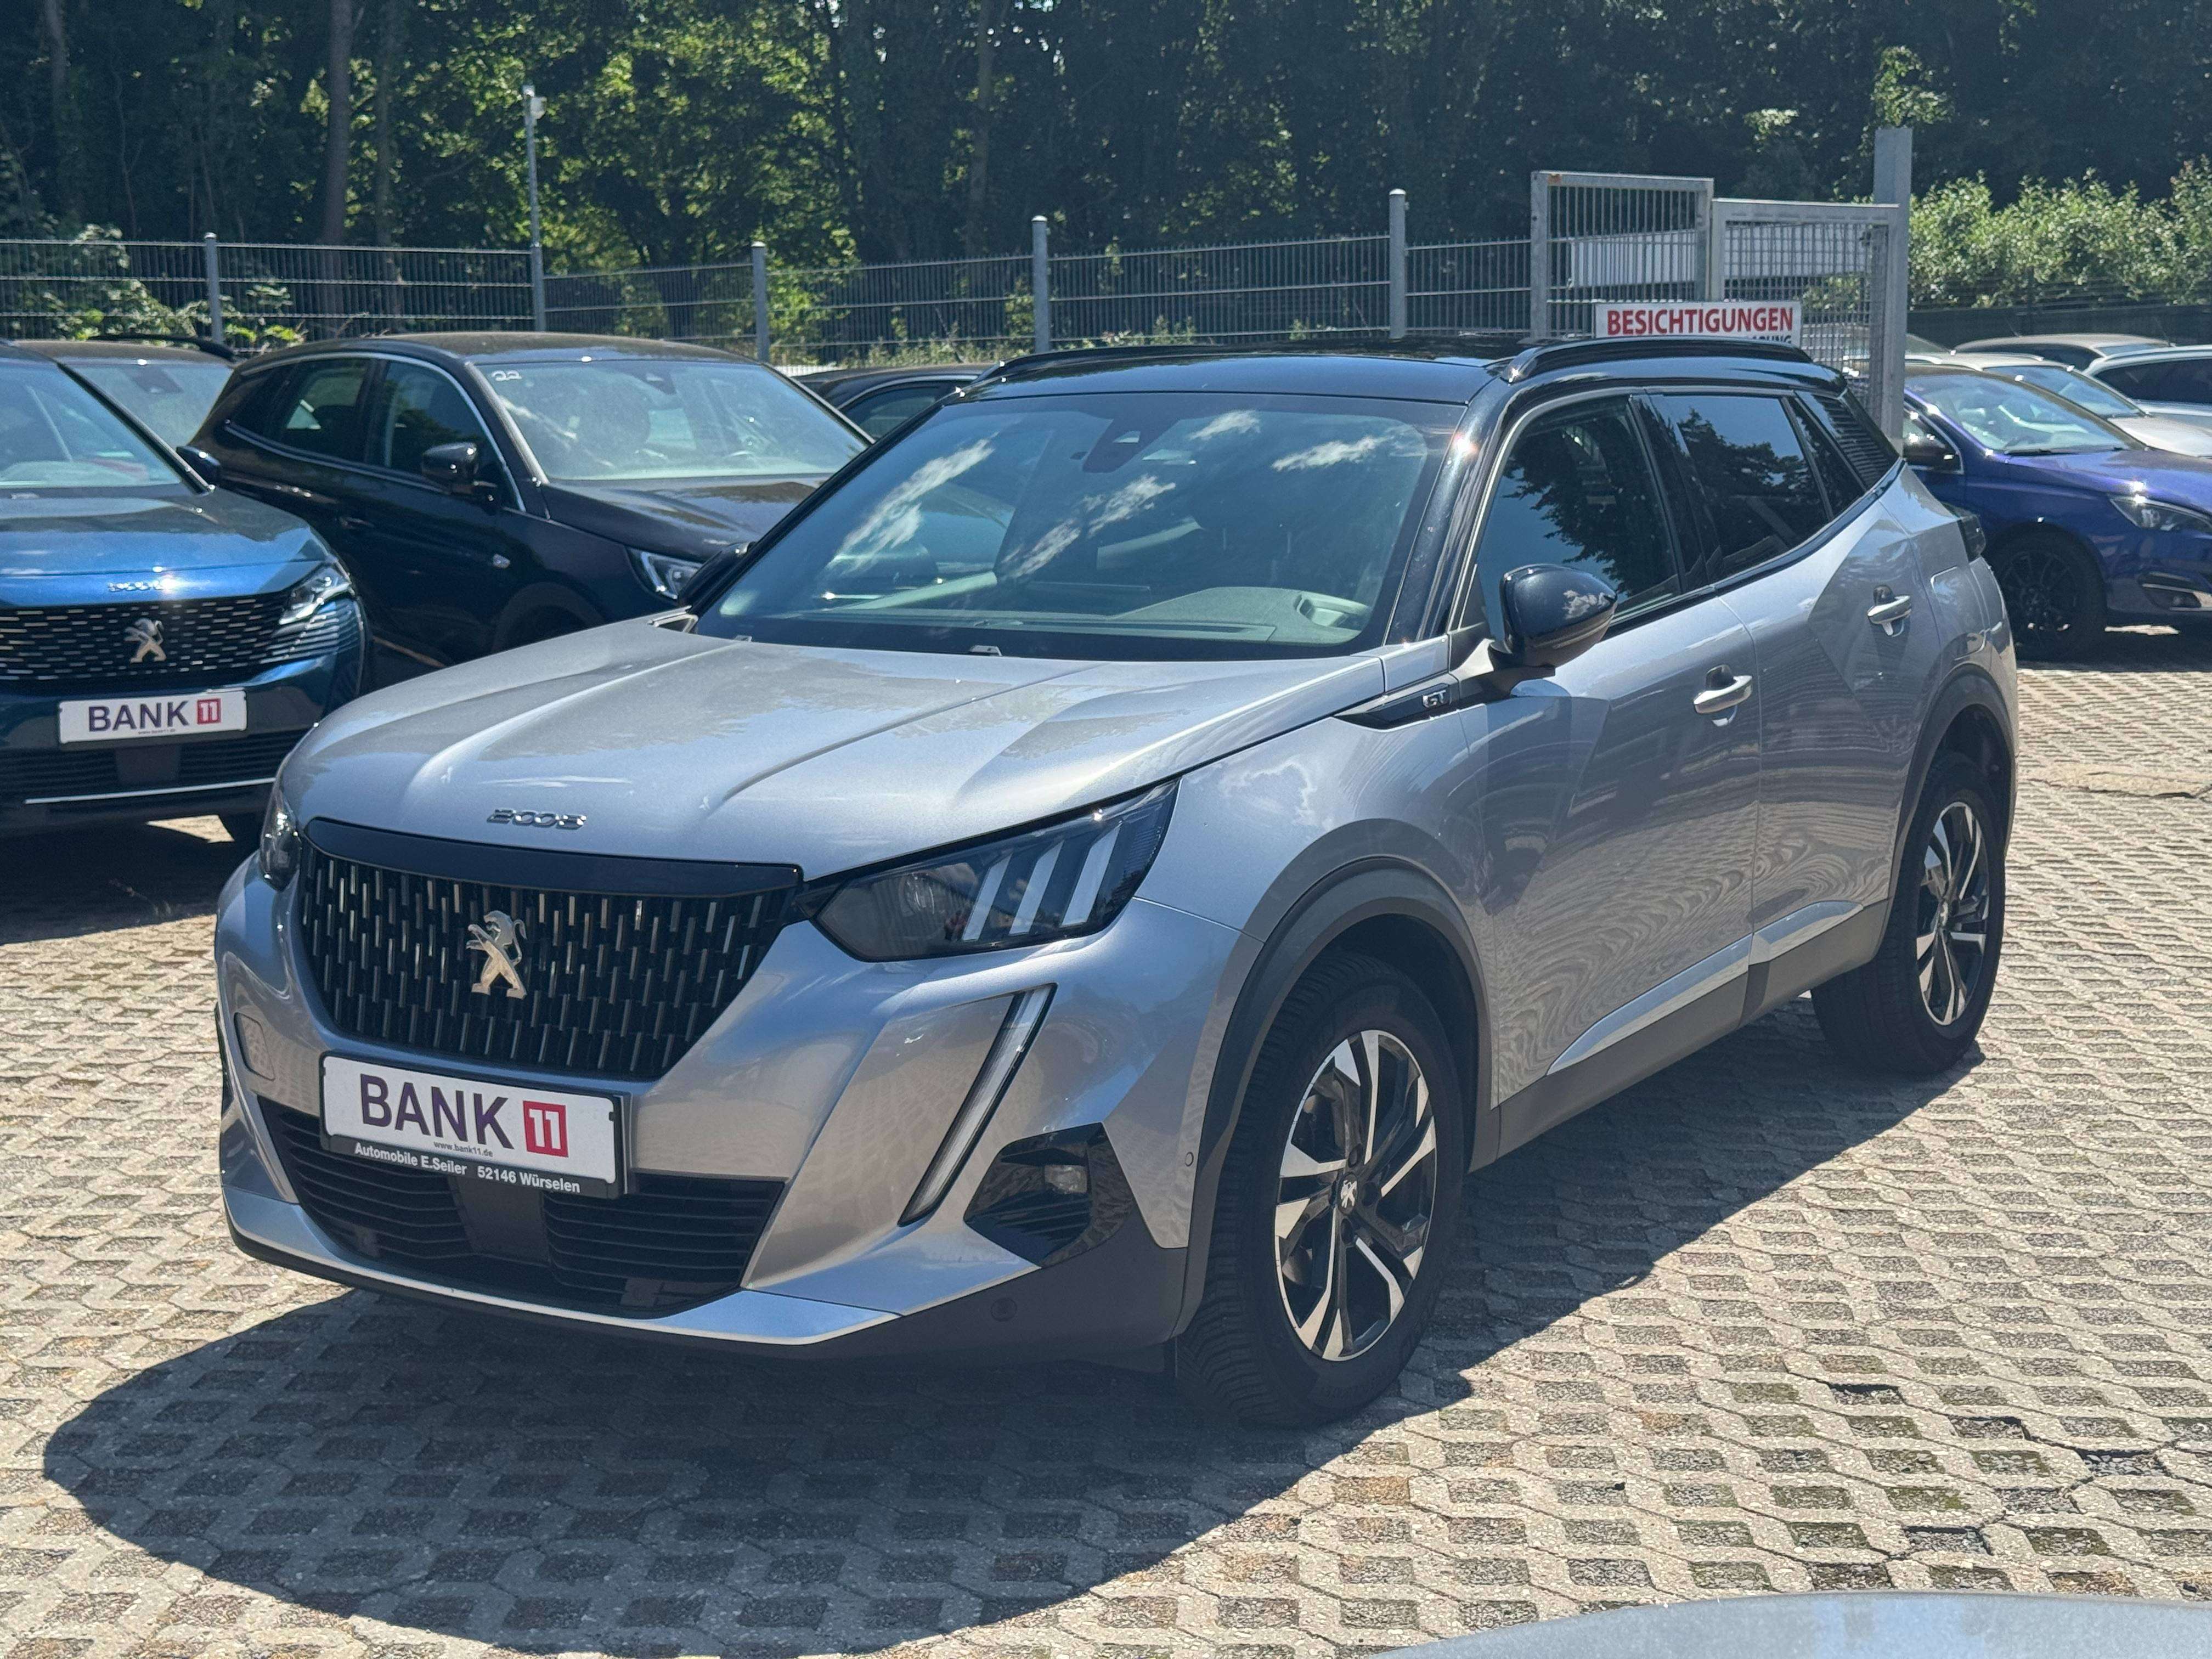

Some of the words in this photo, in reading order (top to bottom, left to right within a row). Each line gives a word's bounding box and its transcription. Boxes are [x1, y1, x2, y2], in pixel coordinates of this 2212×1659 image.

[1607, 307, 1793, 336] BESICHTIGUNGEN
[1423, 689, 1446, 708] GT
[88, 701, 190, 732] BANK
[200, 701, 219, 722] 11
[487, 808, 587, 831] 2008
[360, 1073, 515, 1150] BANK
[527, 1107, 562, 1152] 11
[433, 1141, 493, 1158] www.bank11.de
[354, 1142, 418, 1166] Automobile
[420, 1155, 467, 1175] E.Seiler
[477, 1165, 517, 1184] 52146
[519, 1172, 580, 1193] Würselen
